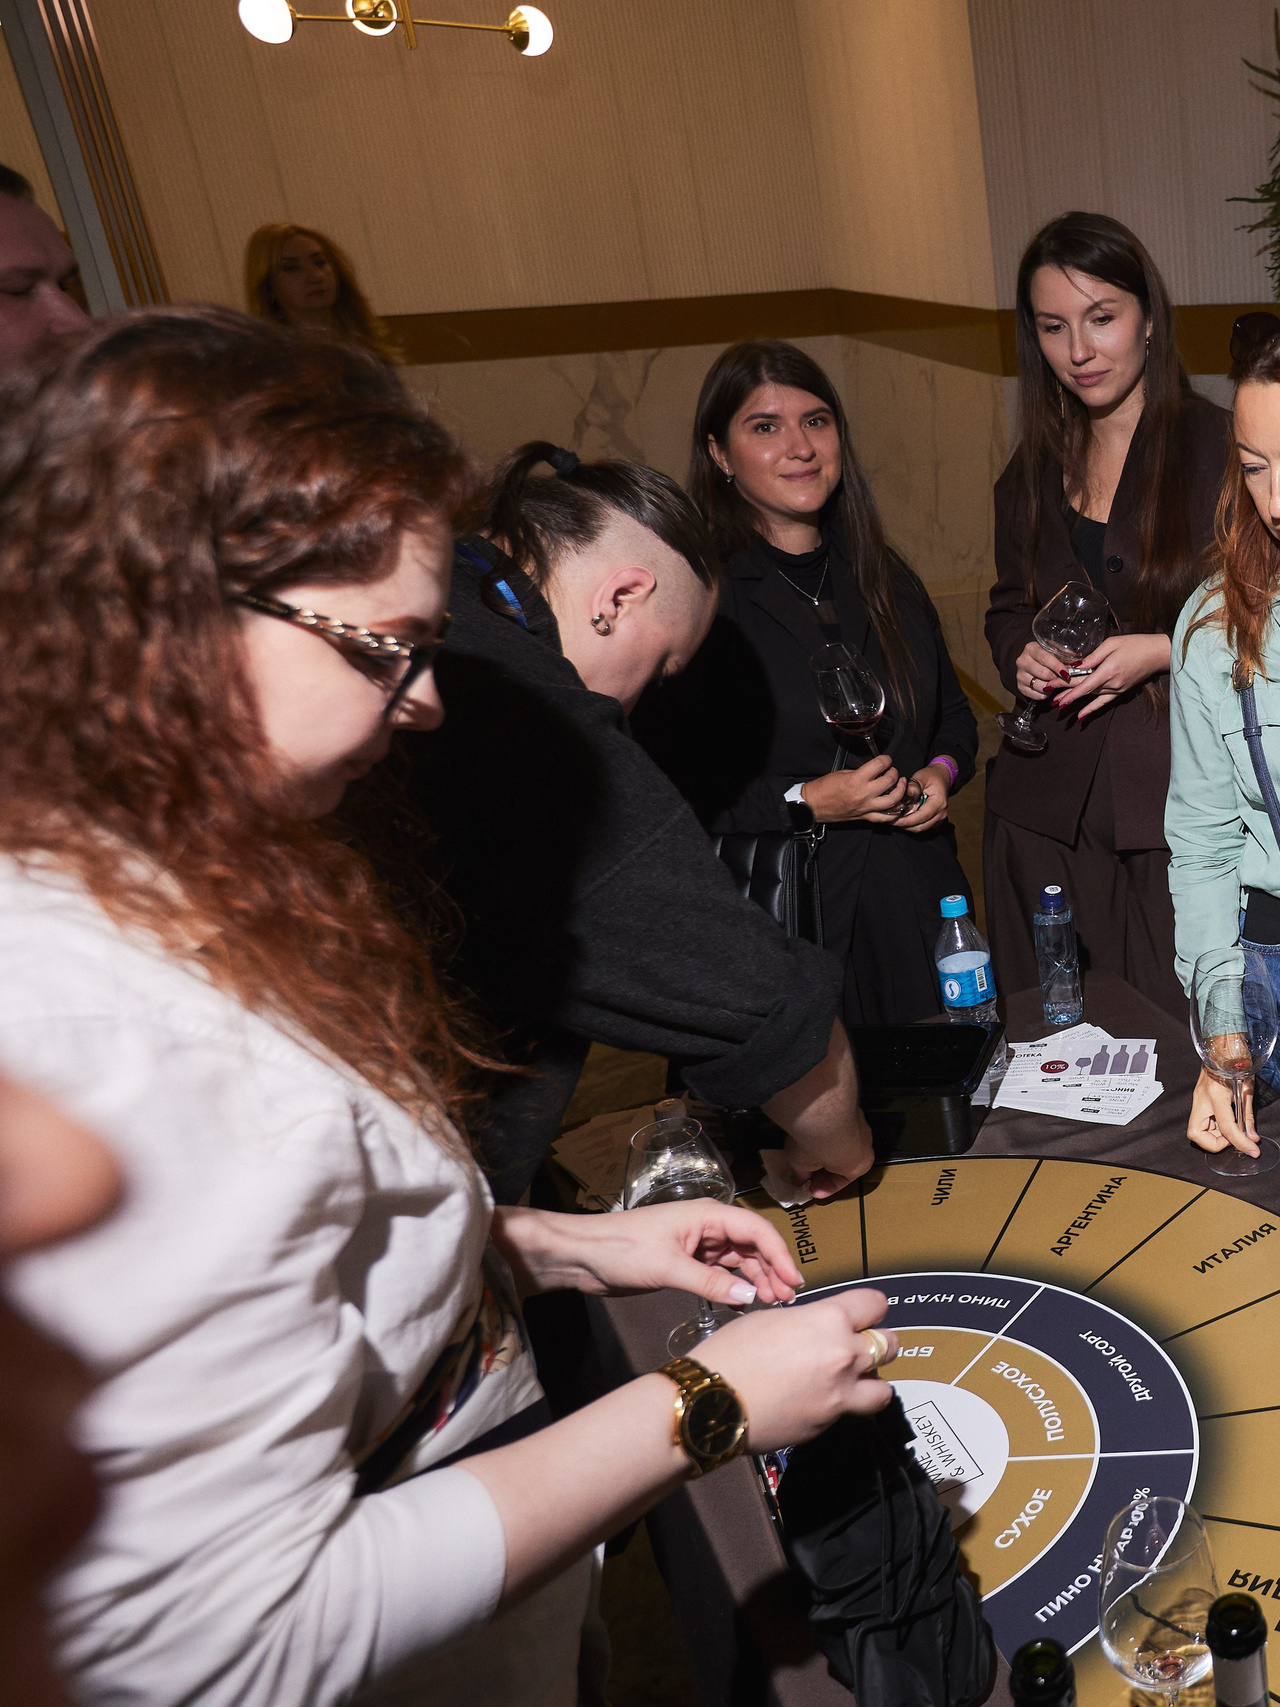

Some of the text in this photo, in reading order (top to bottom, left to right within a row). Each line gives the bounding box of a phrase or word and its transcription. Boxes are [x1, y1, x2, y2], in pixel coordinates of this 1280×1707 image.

[931, 1168, 957, 1206] ЧИЛИ
[1050, 1176, 1128, 1256] АРГЕНТИНА
[788, 1204, 819, 1264] ГЕРМАН
[1192, 1222, 1278, 1274] ИТАЛИЯ
[904, 1293, 955, 1305] НУАР
[958, 1294, 1011, 1309] ПИНО
[1078, 1330, 1154, 1402] ДРУГОЙ СОРТ
[990, 1360, 1065, 1442] ПОЛУСУХОЕ
[912, 1415, 965, 1477] & WHISKEY
[994, 1488, 1053, 1548] СУХОЕ
[1034, 1574, 1092, 1623] ПИНО
[1127, 1486, 1151, 1528] 100%
